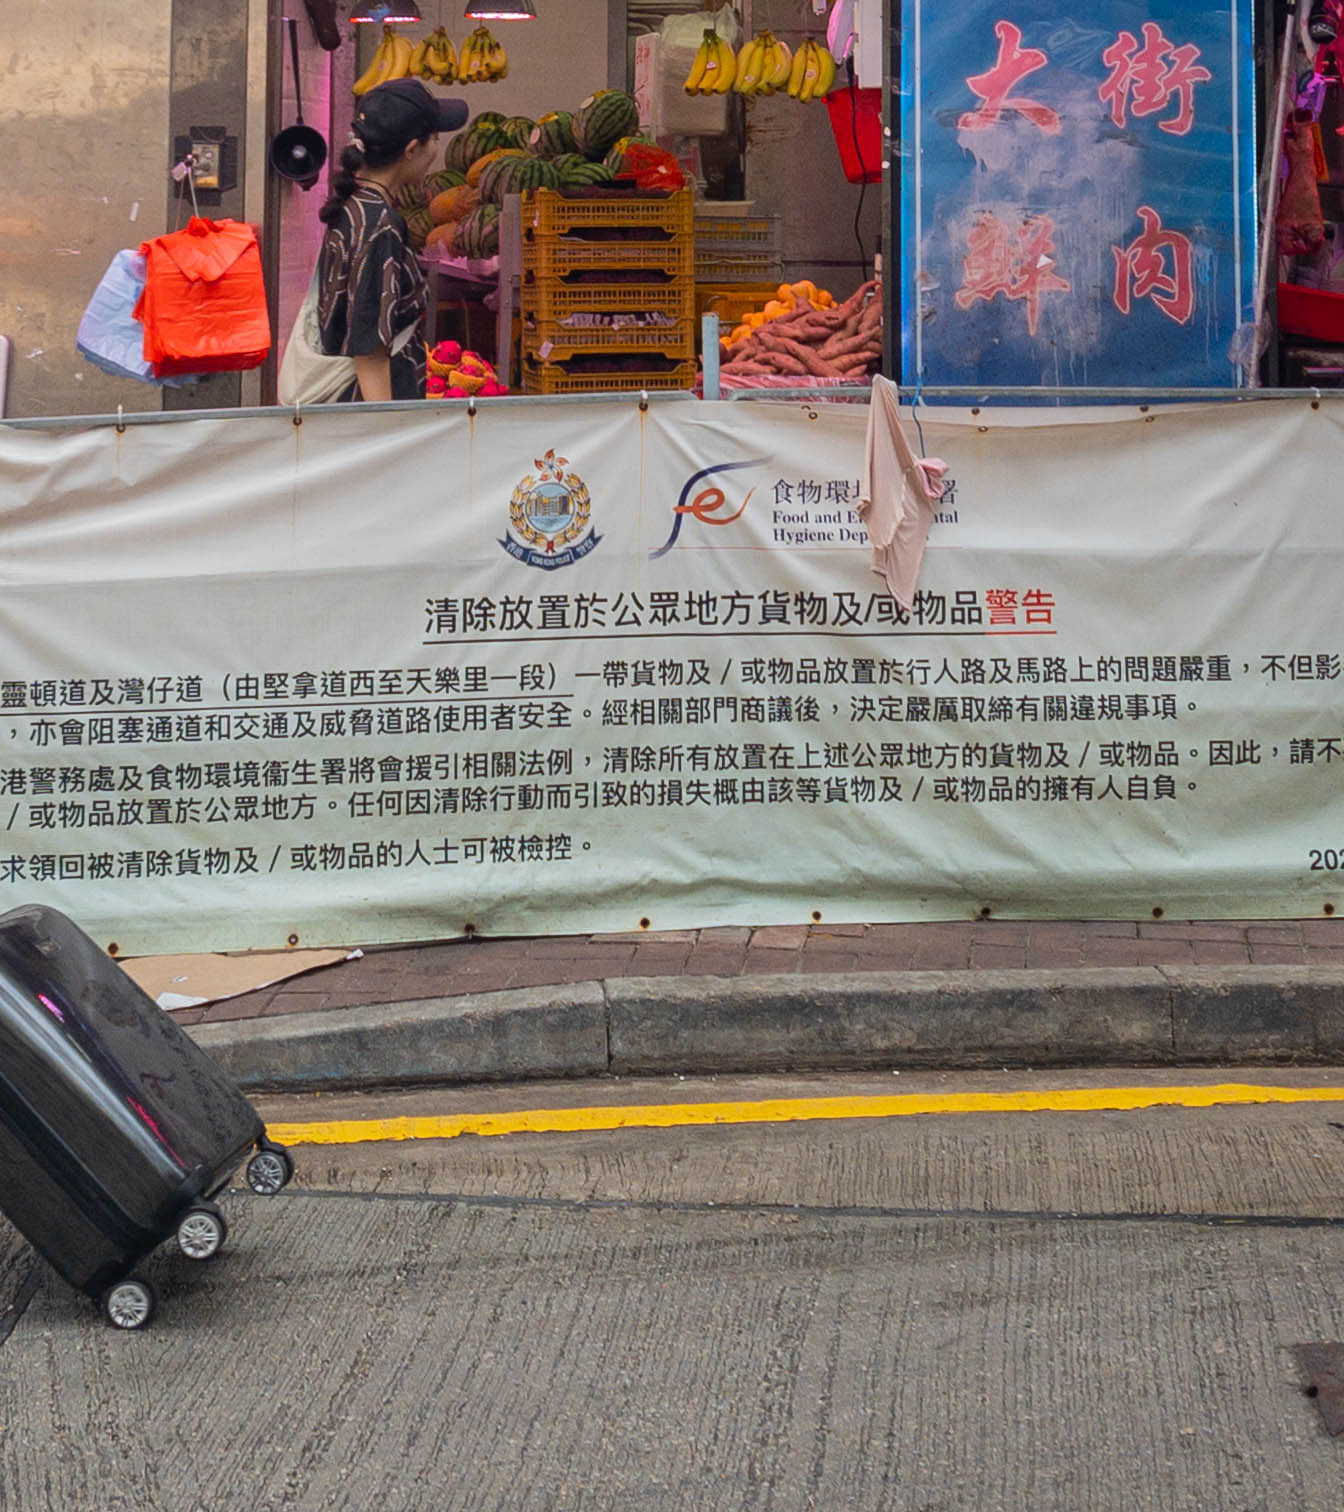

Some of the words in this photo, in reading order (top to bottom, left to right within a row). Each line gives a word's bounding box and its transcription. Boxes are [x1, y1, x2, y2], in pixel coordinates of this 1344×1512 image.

[956, 19, 1213, 136] 大街
[954, 204, 1196, 338] 鮮肉
[772, 510, 809, 524] Food
[814, 510, 842, 524] and
[773, 528, 834, 545] Hygiene
